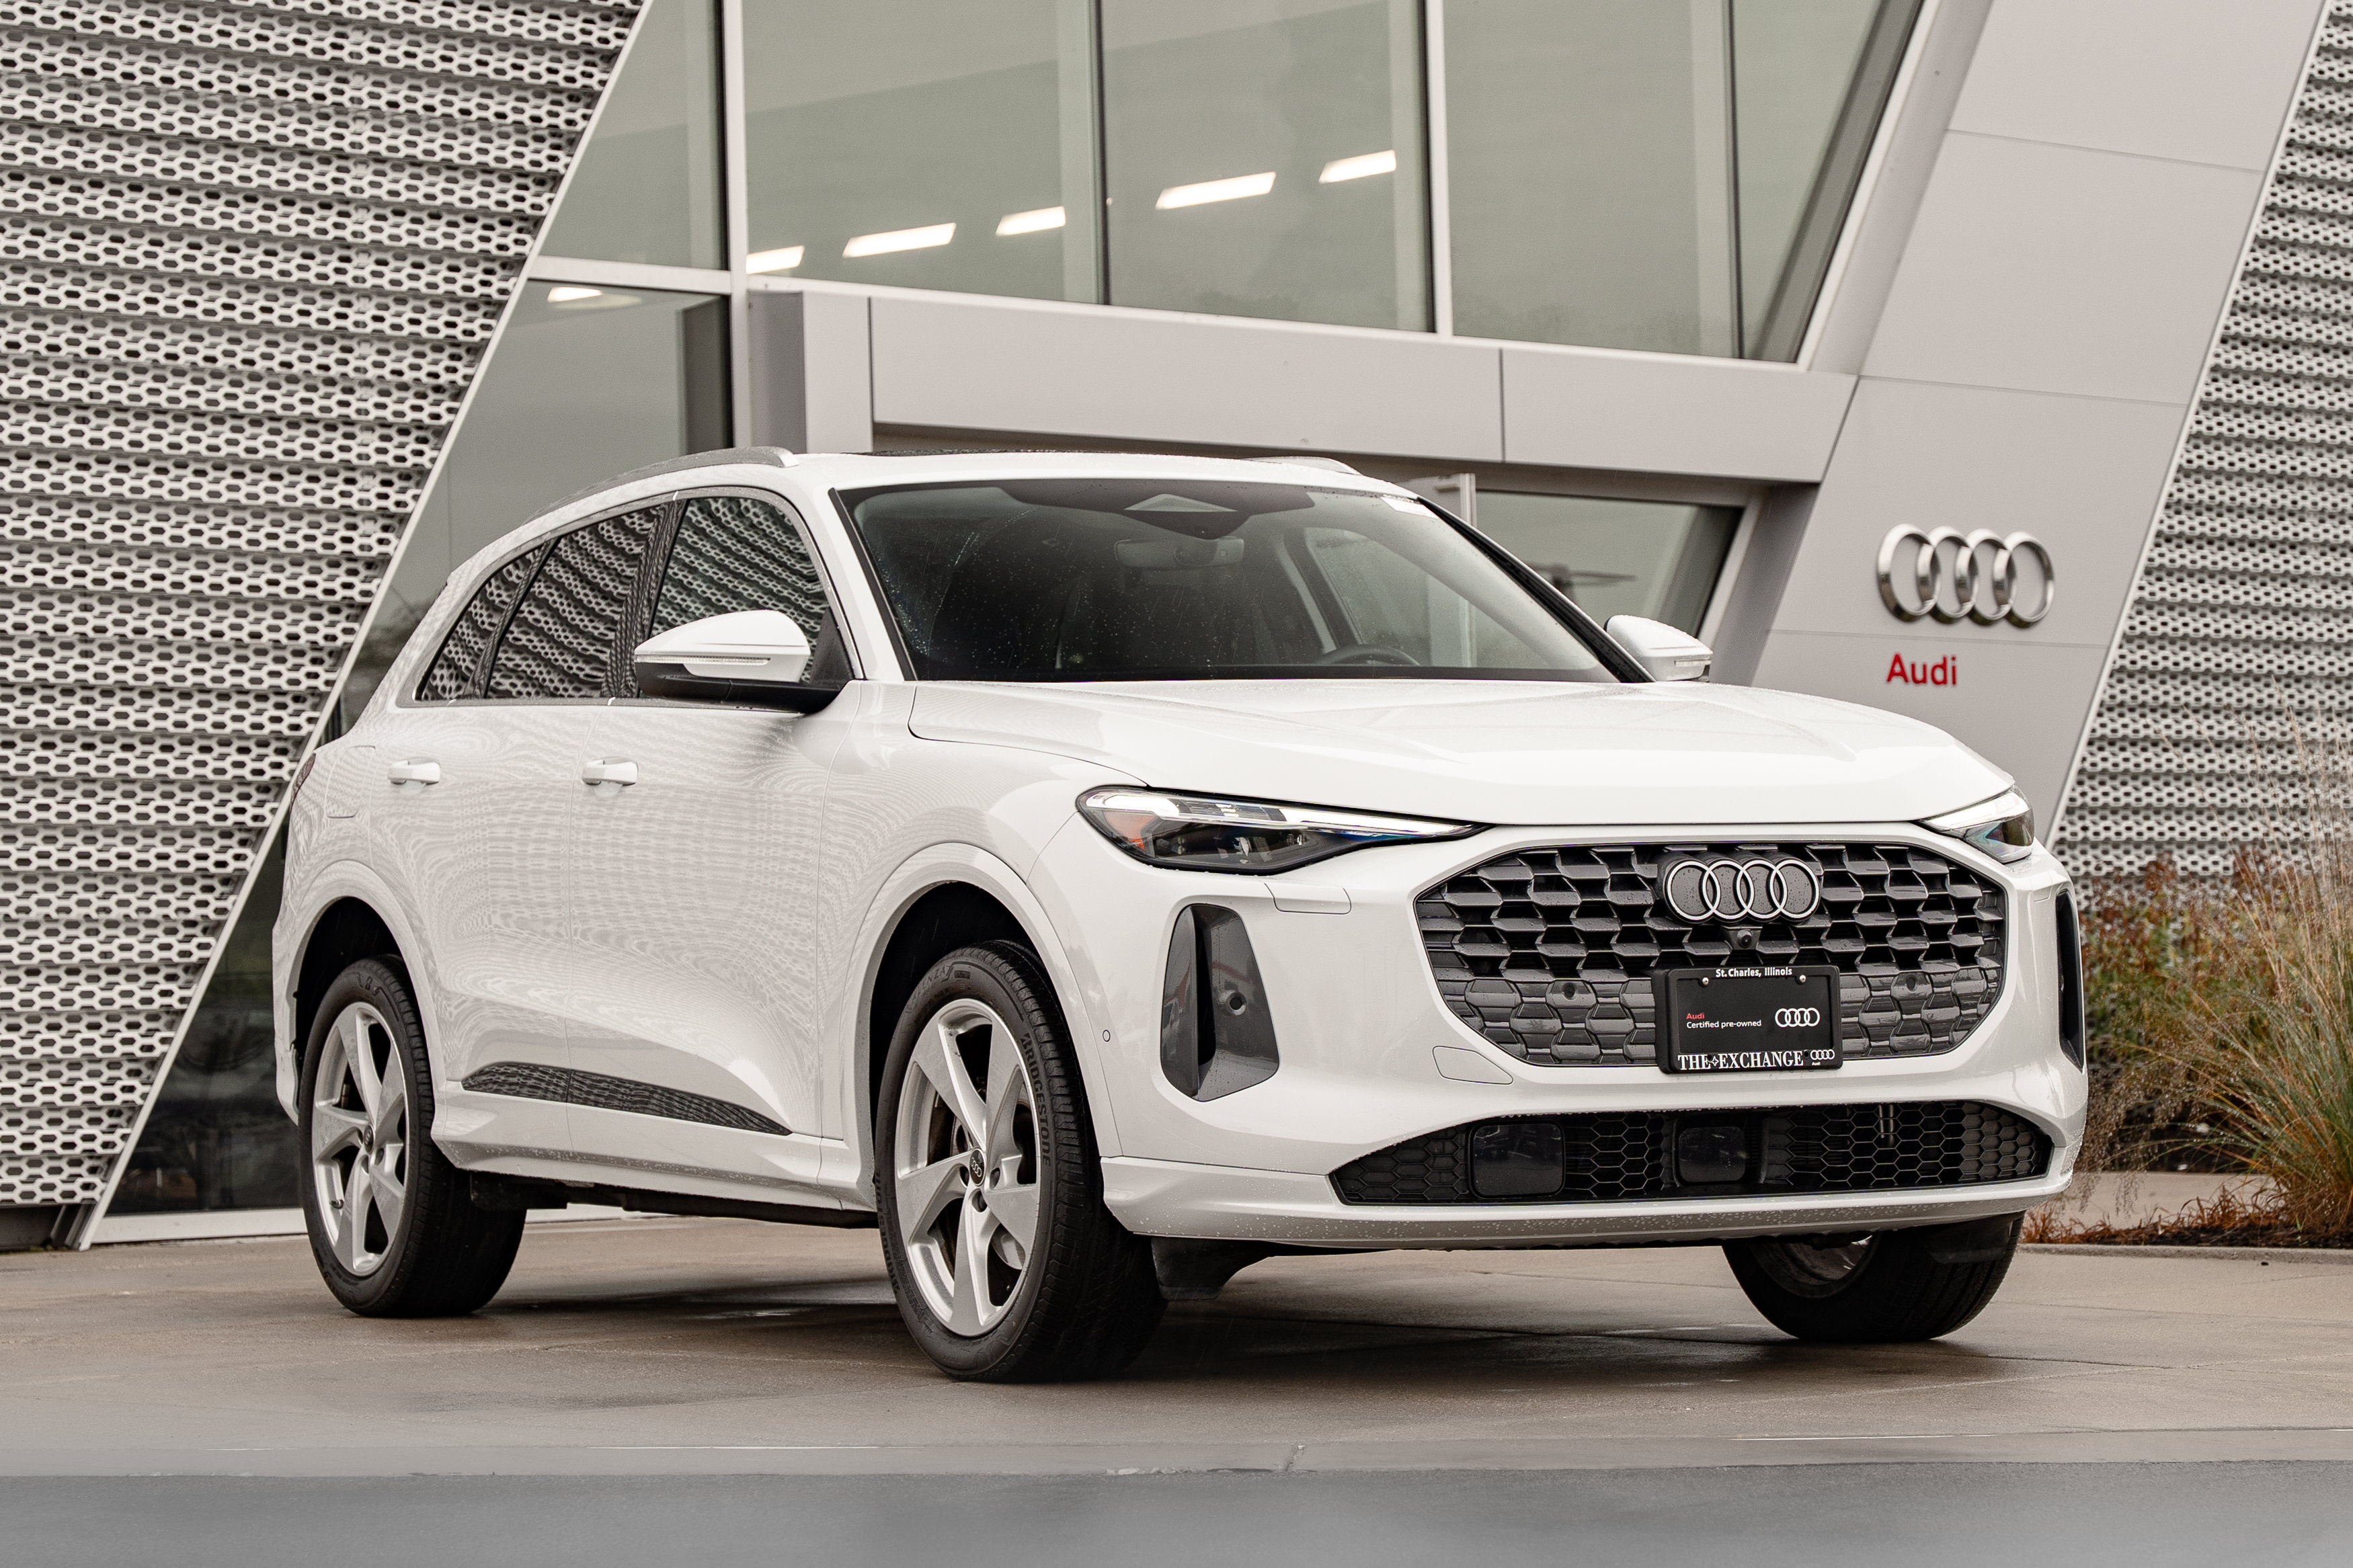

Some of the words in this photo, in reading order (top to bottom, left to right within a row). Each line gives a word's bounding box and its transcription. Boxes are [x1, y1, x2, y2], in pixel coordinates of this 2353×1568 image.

[1886, 653, 1956, 686] Audi
[1715, 968, 1727, 978] St.
[1728, 968, 1761, 977] Charles,
[1764, 966, 1792, 976] Illinois
[1686, 1020, 1720, 1029] Certified
[1721, 1020, 1762, 1029] pre-owned
[1677, 1054, 1711, 1070] THE
[1718, 1050, 1804, 1069] EXCHANGE
[1021, 1032, 1051, 1167] BRIDGESTONE
